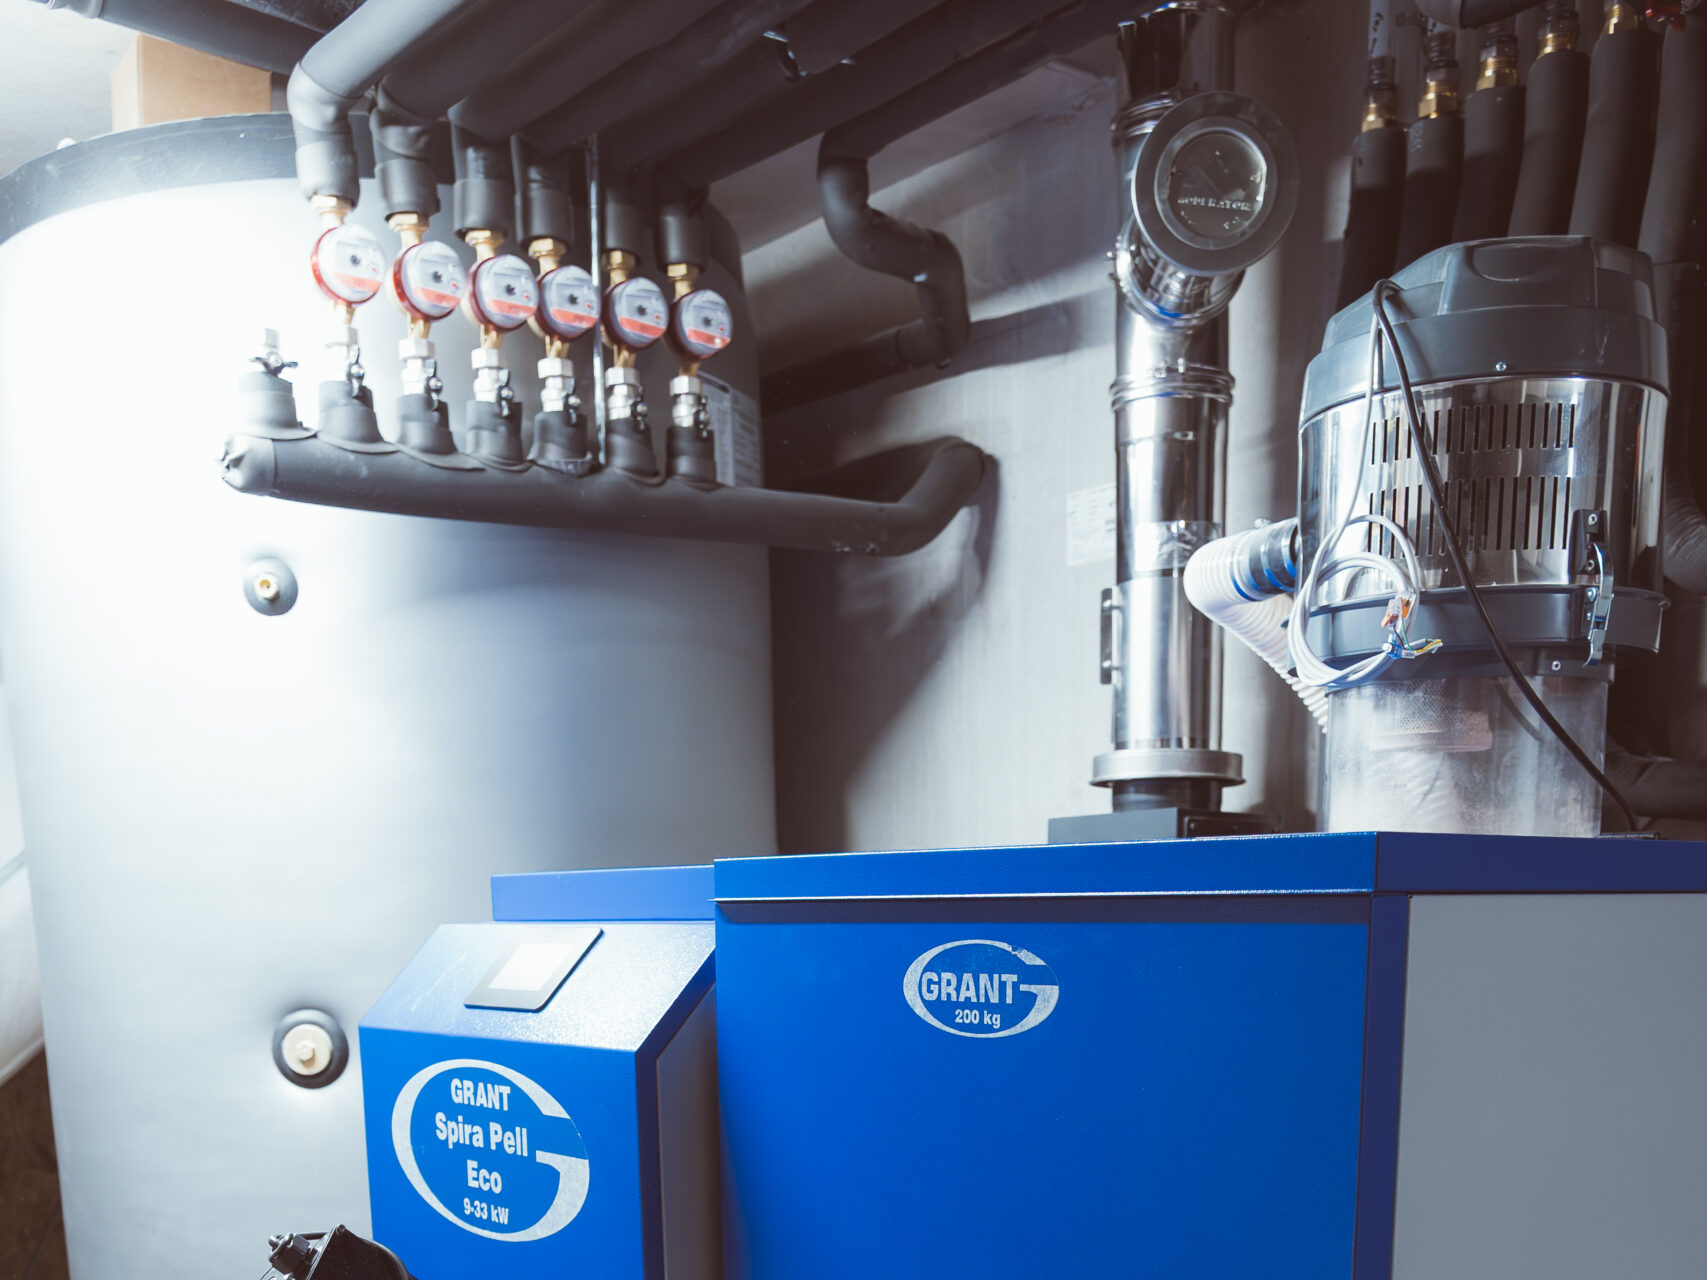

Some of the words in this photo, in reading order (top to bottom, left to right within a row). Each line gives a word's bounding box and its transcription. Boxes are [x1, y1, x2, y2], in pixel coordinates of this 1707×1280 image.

[921, 971, 1018, 1005] GRANT
[954, 1008, 980, 1025] 200
[983, 1010, 1001, 1029] kg
[450, 1077, 511, 1112] GRANT
[435, 1112, 484, 1149] Spira
[489, 1121, 528, 1157] Pell
[466, 1159, 503, 1195] Eco
[463, 1197, 488, 1220] 9-33
[490, 1204, 509, 1226] kW
